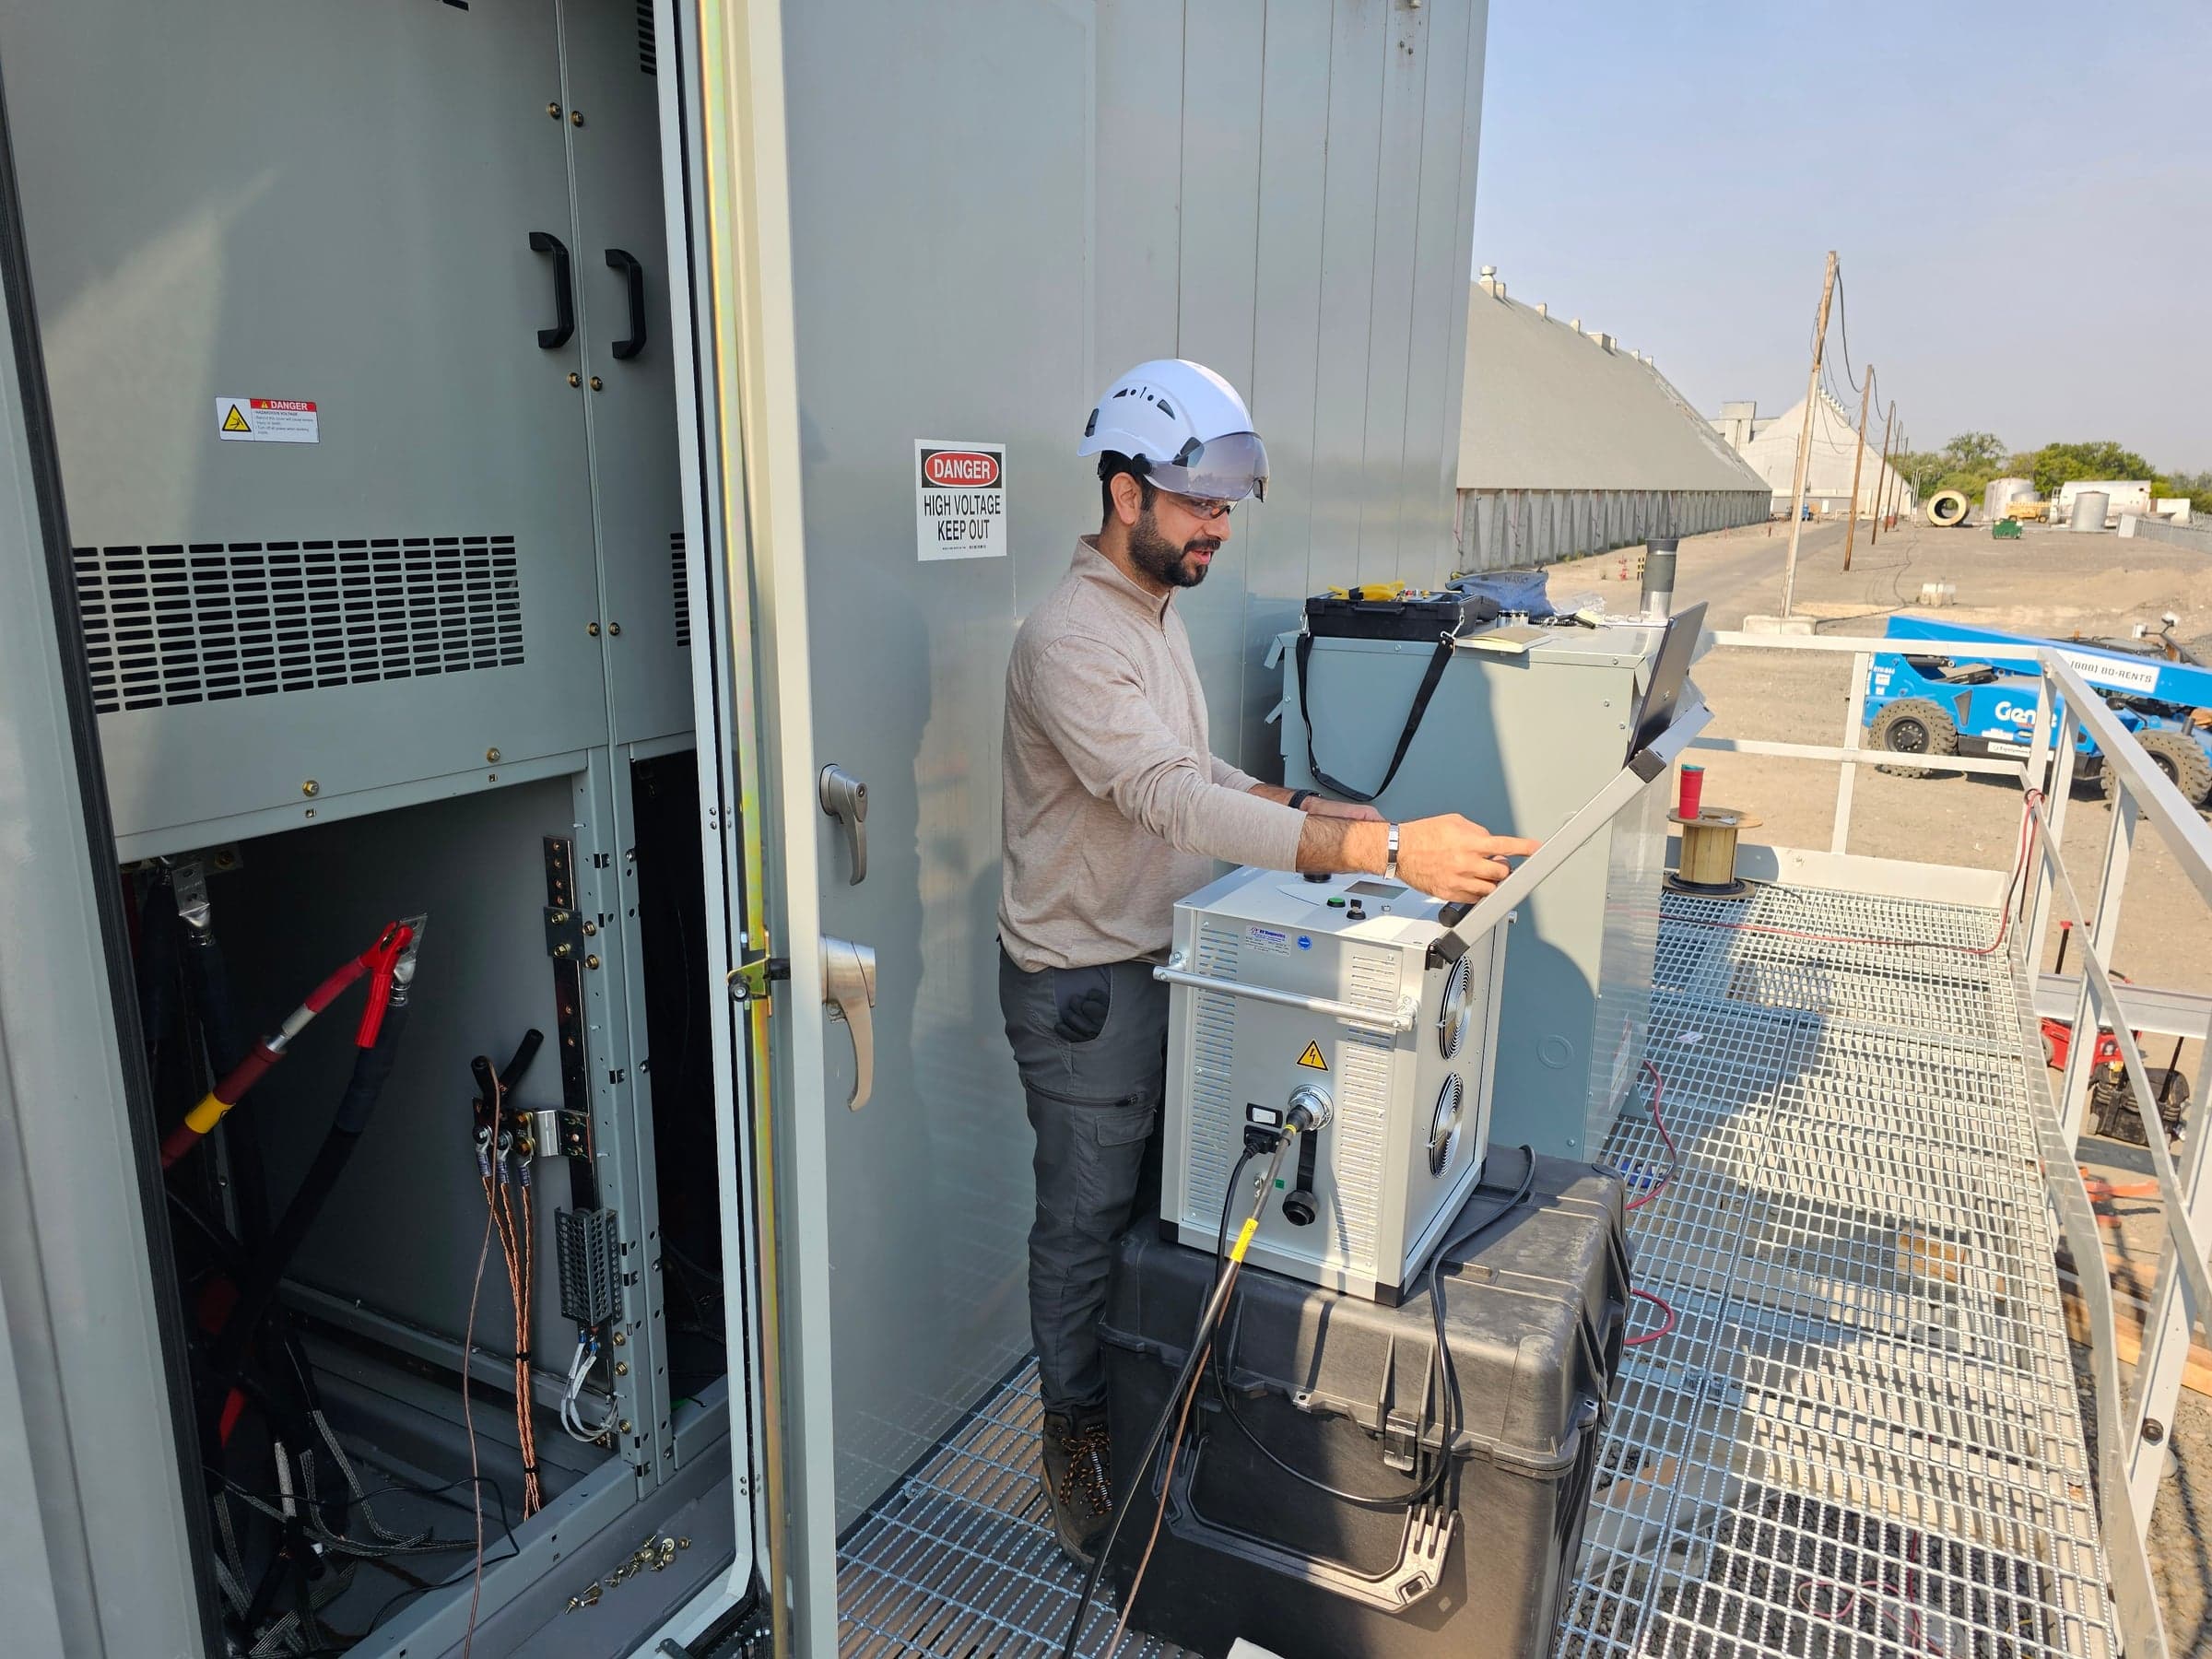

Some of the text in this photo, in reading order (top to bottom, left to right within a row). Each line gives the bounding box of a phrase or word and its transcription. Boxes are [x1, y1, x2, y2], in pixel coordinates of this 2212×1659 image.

[270, 401, 308, 410] DANGER
[934, 458, 991, 479] DANGER
[924, 494, 1001, 516] HIGH VOLTAGE
[937, 519, 990, 541] KEEP OUT
[1994, 700, 2058, 728] Gen
